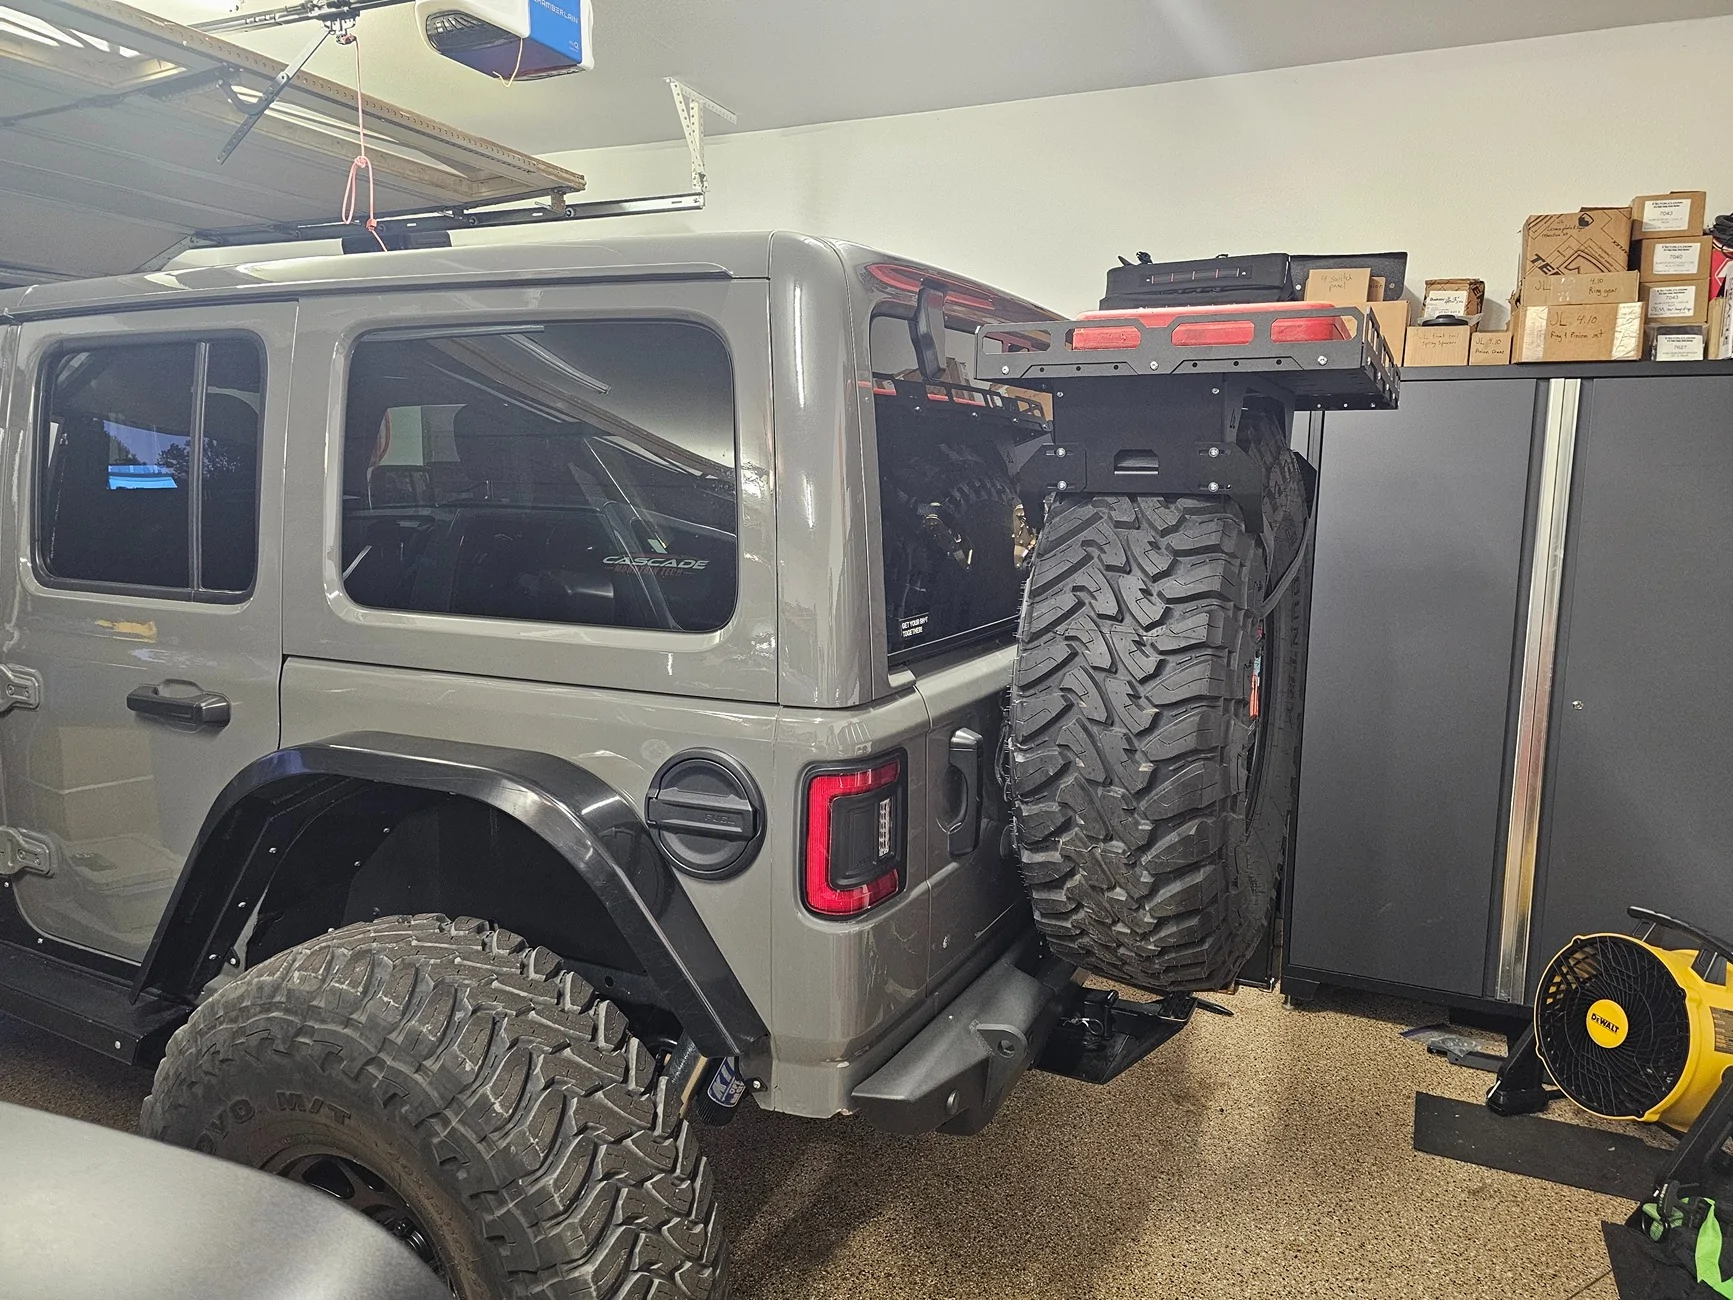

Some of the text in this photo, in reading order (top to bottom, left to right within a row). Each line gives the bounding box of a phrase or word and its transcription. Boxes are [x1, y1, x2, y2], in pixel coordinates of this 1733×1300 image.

[1534, 280, 1551, 291] JL
[1549, 311, 1598, 327] JL 4.10
[602, 556, 709, 570] CASCADE
